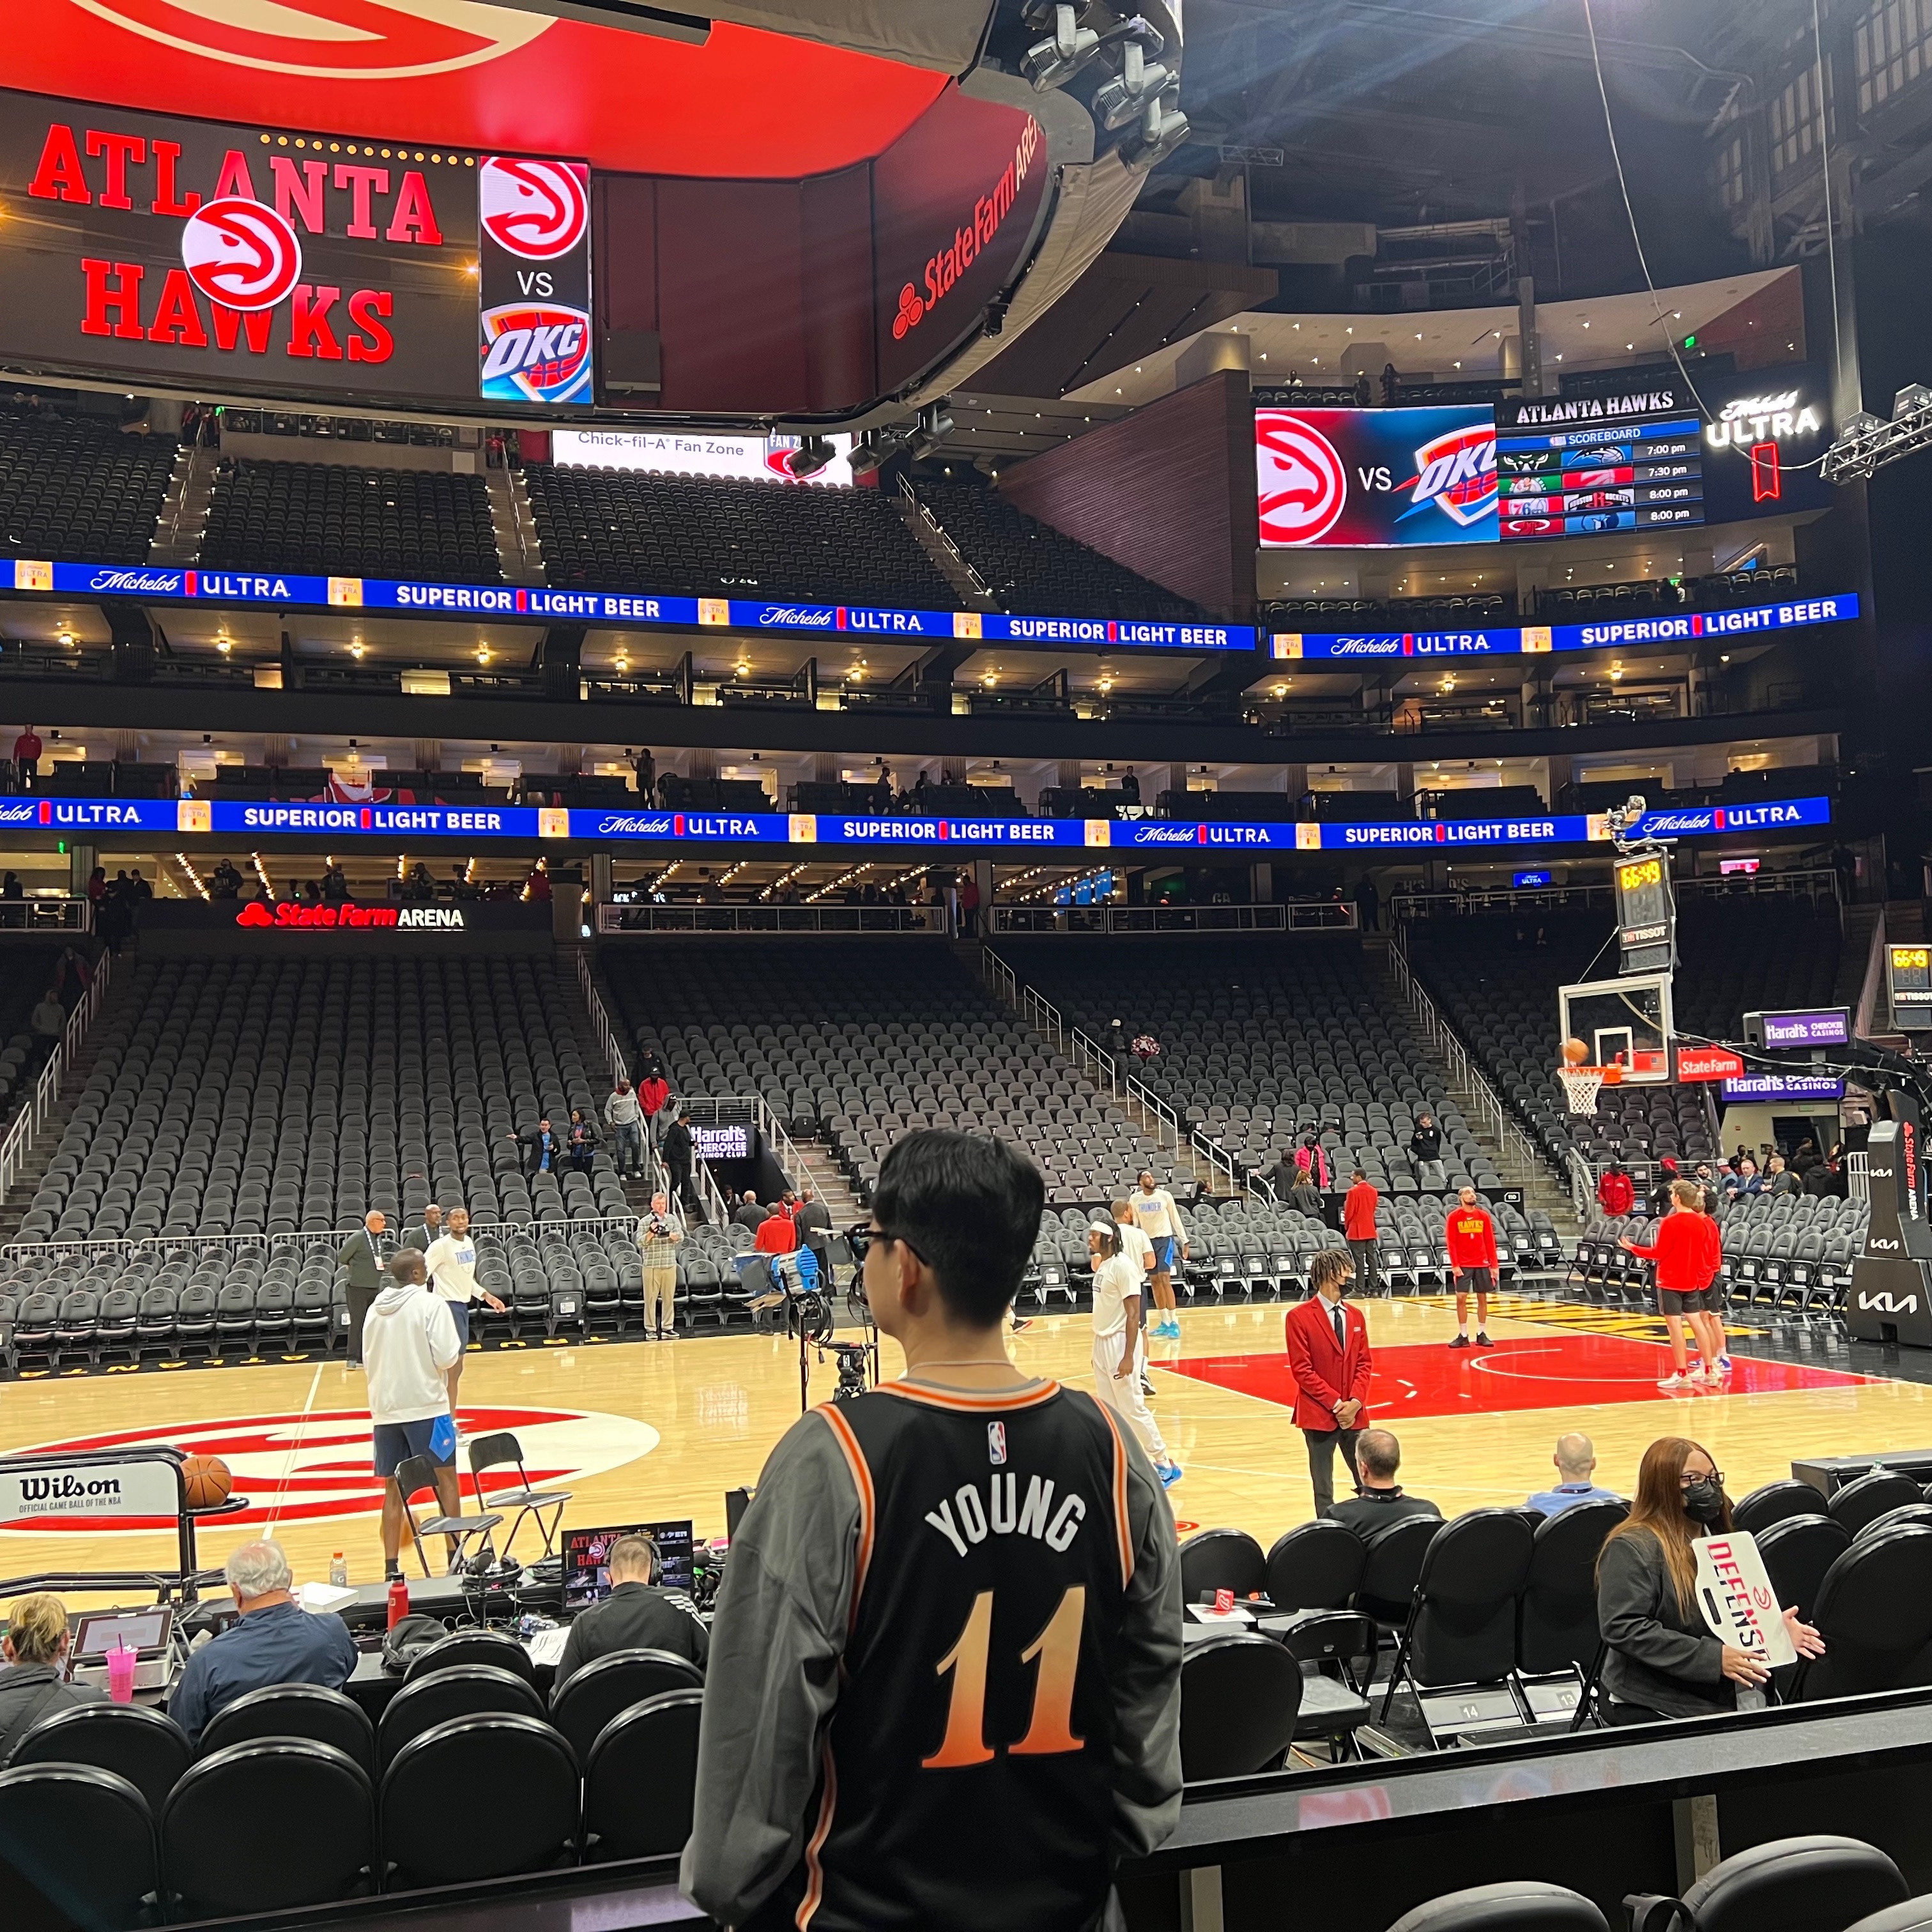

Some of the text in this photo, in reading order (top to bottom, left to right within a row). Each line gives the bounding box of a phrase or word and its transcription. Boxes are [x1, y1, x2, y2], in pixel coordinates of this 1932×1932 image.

[28, 125, 443, 245] ATLANTA
[516, 270, 554, 296] VS
[81, 258, 394, 363] HAWKS
[483, 321, 585, 381] OKC
[1517, 390, 1674, 424] ATLANTA HAWKS
[1706, 405, 1820, 447] ULTRA
[770, 435, 790, 448] FAN
[1568, 427, 1641, 445] SCOREBOARD
[675, 440, 702, 452] Fan
[705, 441, 744, 456] Zone
[1647, 444, 1686, 455] 7:00 pm
[1358, 466, 1393, 492] VS
[1648, 466, 1687, 477] 7:30 pm
[1650, 488, 1689, 500] 8:00 pm
[1650, 510, 1690, 521] 8:00 pm
[203, 574, 291, 597] ULTRA
[396, 585, 660, 617] SUPERIOR LIGHT BEER
[850, 611, 923, 631] ULTRA
[1581, 599, 1837, 645] SUPERIOR LIGHT BEER
[1009, 619, 1228, 645] SUPERIOR LIGHT BEER
[1416, 634, 1491, 652] ULTRA
[56, 805, 142, 824] ULTRA
[243, 808, 501, 830] SUPERIOR LIGHT BEER
[1729, 805, 1802, 826] ULTRA
[689, 818, 760, 835] ULTRA
[843, 821, 1055, 840] SUPERIOR LIGHT BEER
[1210, 828, 1271, 843] ULTRA
[1345, 822, 1555, 843] SUPERIOR LIGHT BEER
[397, 908, 464, 927] ARENA
[1811, 1027, 1844, 1037] CASINOS
[698, 1141, 747, 1153] HEROKEE
[1908, 1188, 1919, 1222] ARENA
[1457, 1220, 1483, 1229] HAWKS
[19, 1475, 121, 1501] Wilson
[19, 1496, 121, 1514] OFFICIAL GAME BALL OF THE NBA
[924, 1472, 1086, 1558] YOUNG
[921, 1586, 1085, 1768] 11
[1561, 1691, 1575, 1706] 13
[1463, 1705, 1478, 1719] 14
